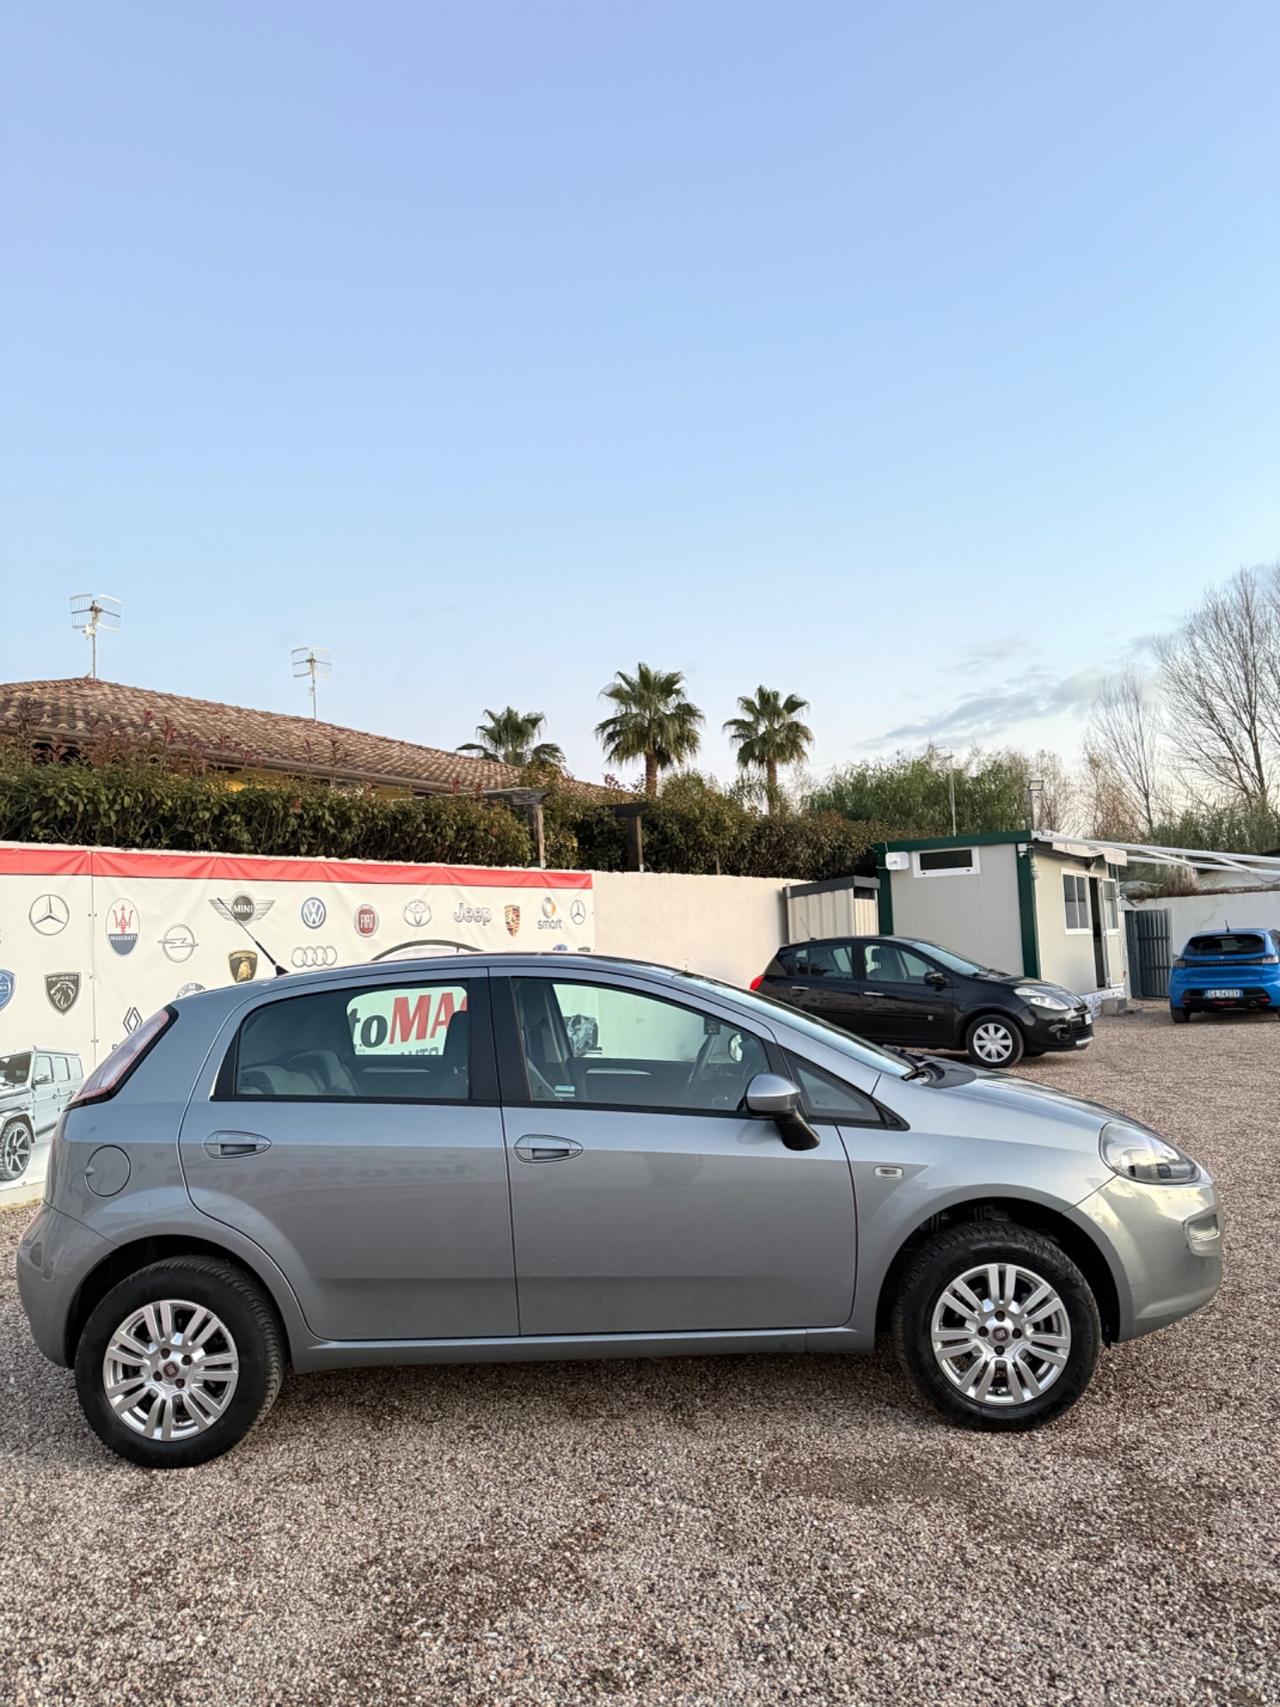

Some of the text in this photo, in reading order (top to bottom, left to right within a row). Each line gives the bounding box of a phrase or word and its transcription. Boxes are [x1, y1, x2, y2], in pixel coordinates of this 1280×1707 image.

[233, 904, 253, 913] MINI
[453, 902, 493, 926] Jeep
[537, 919, 562, 930] smart
